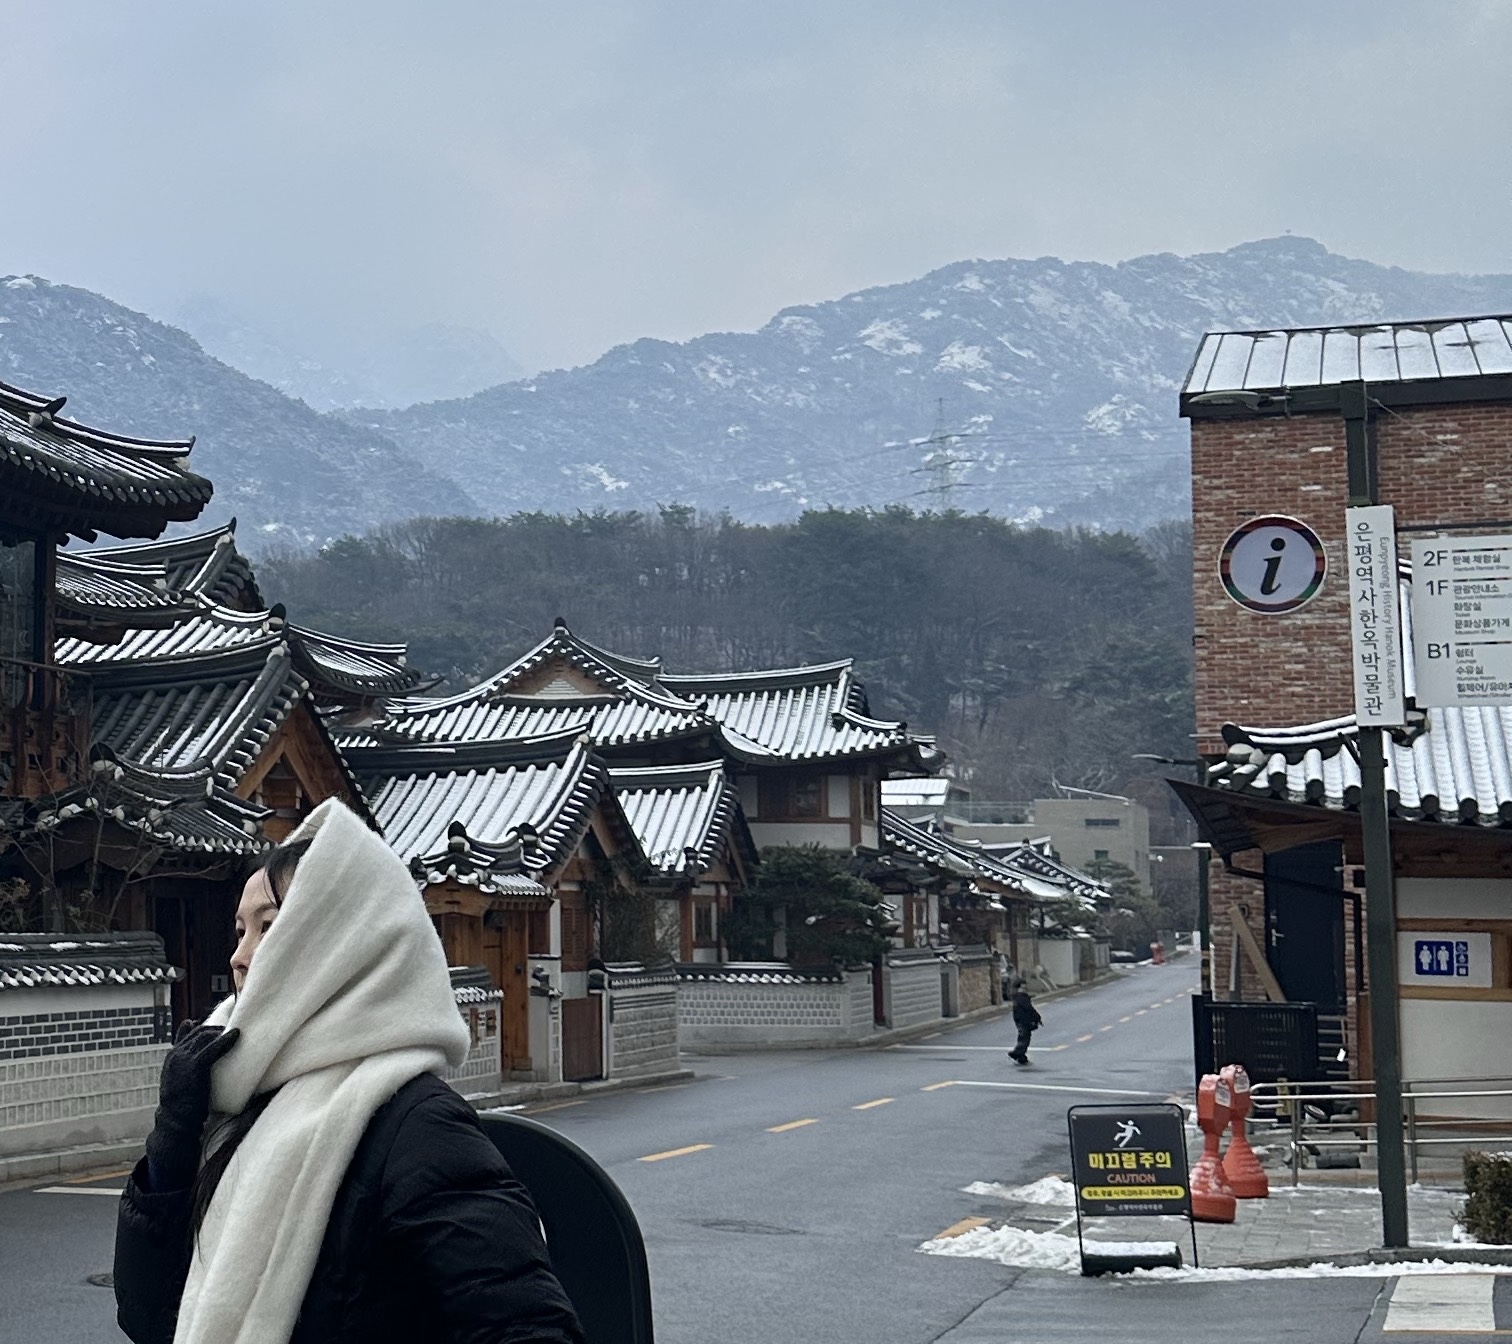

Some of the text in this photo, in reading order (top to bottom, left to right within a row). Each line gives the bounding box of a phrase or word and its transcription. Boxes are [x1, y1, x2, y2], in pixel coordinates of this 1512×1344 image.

[1423, 550, 1448, 567] 2F
[1426, 580, 1449, 596] 1F
[1453, 584, 1500, 594] 관광안내소
[1454, 602, 1482, 611] 화장실
[1353, 522, 1383, 716] 은평역사한옥박물관
[1380, 536, 1396, 699] Eunpyeong History Hanok Museum
[1454, 617, 1510, 629] 문화상품가게
[1427, 642, 1451, 659] B1
[1456, 665, 1484, 675] 수유실
[1088, 1152, 1172, 1170] 미끄럼 주의
[1107, 1173, 1156, 1184] CAUTION
